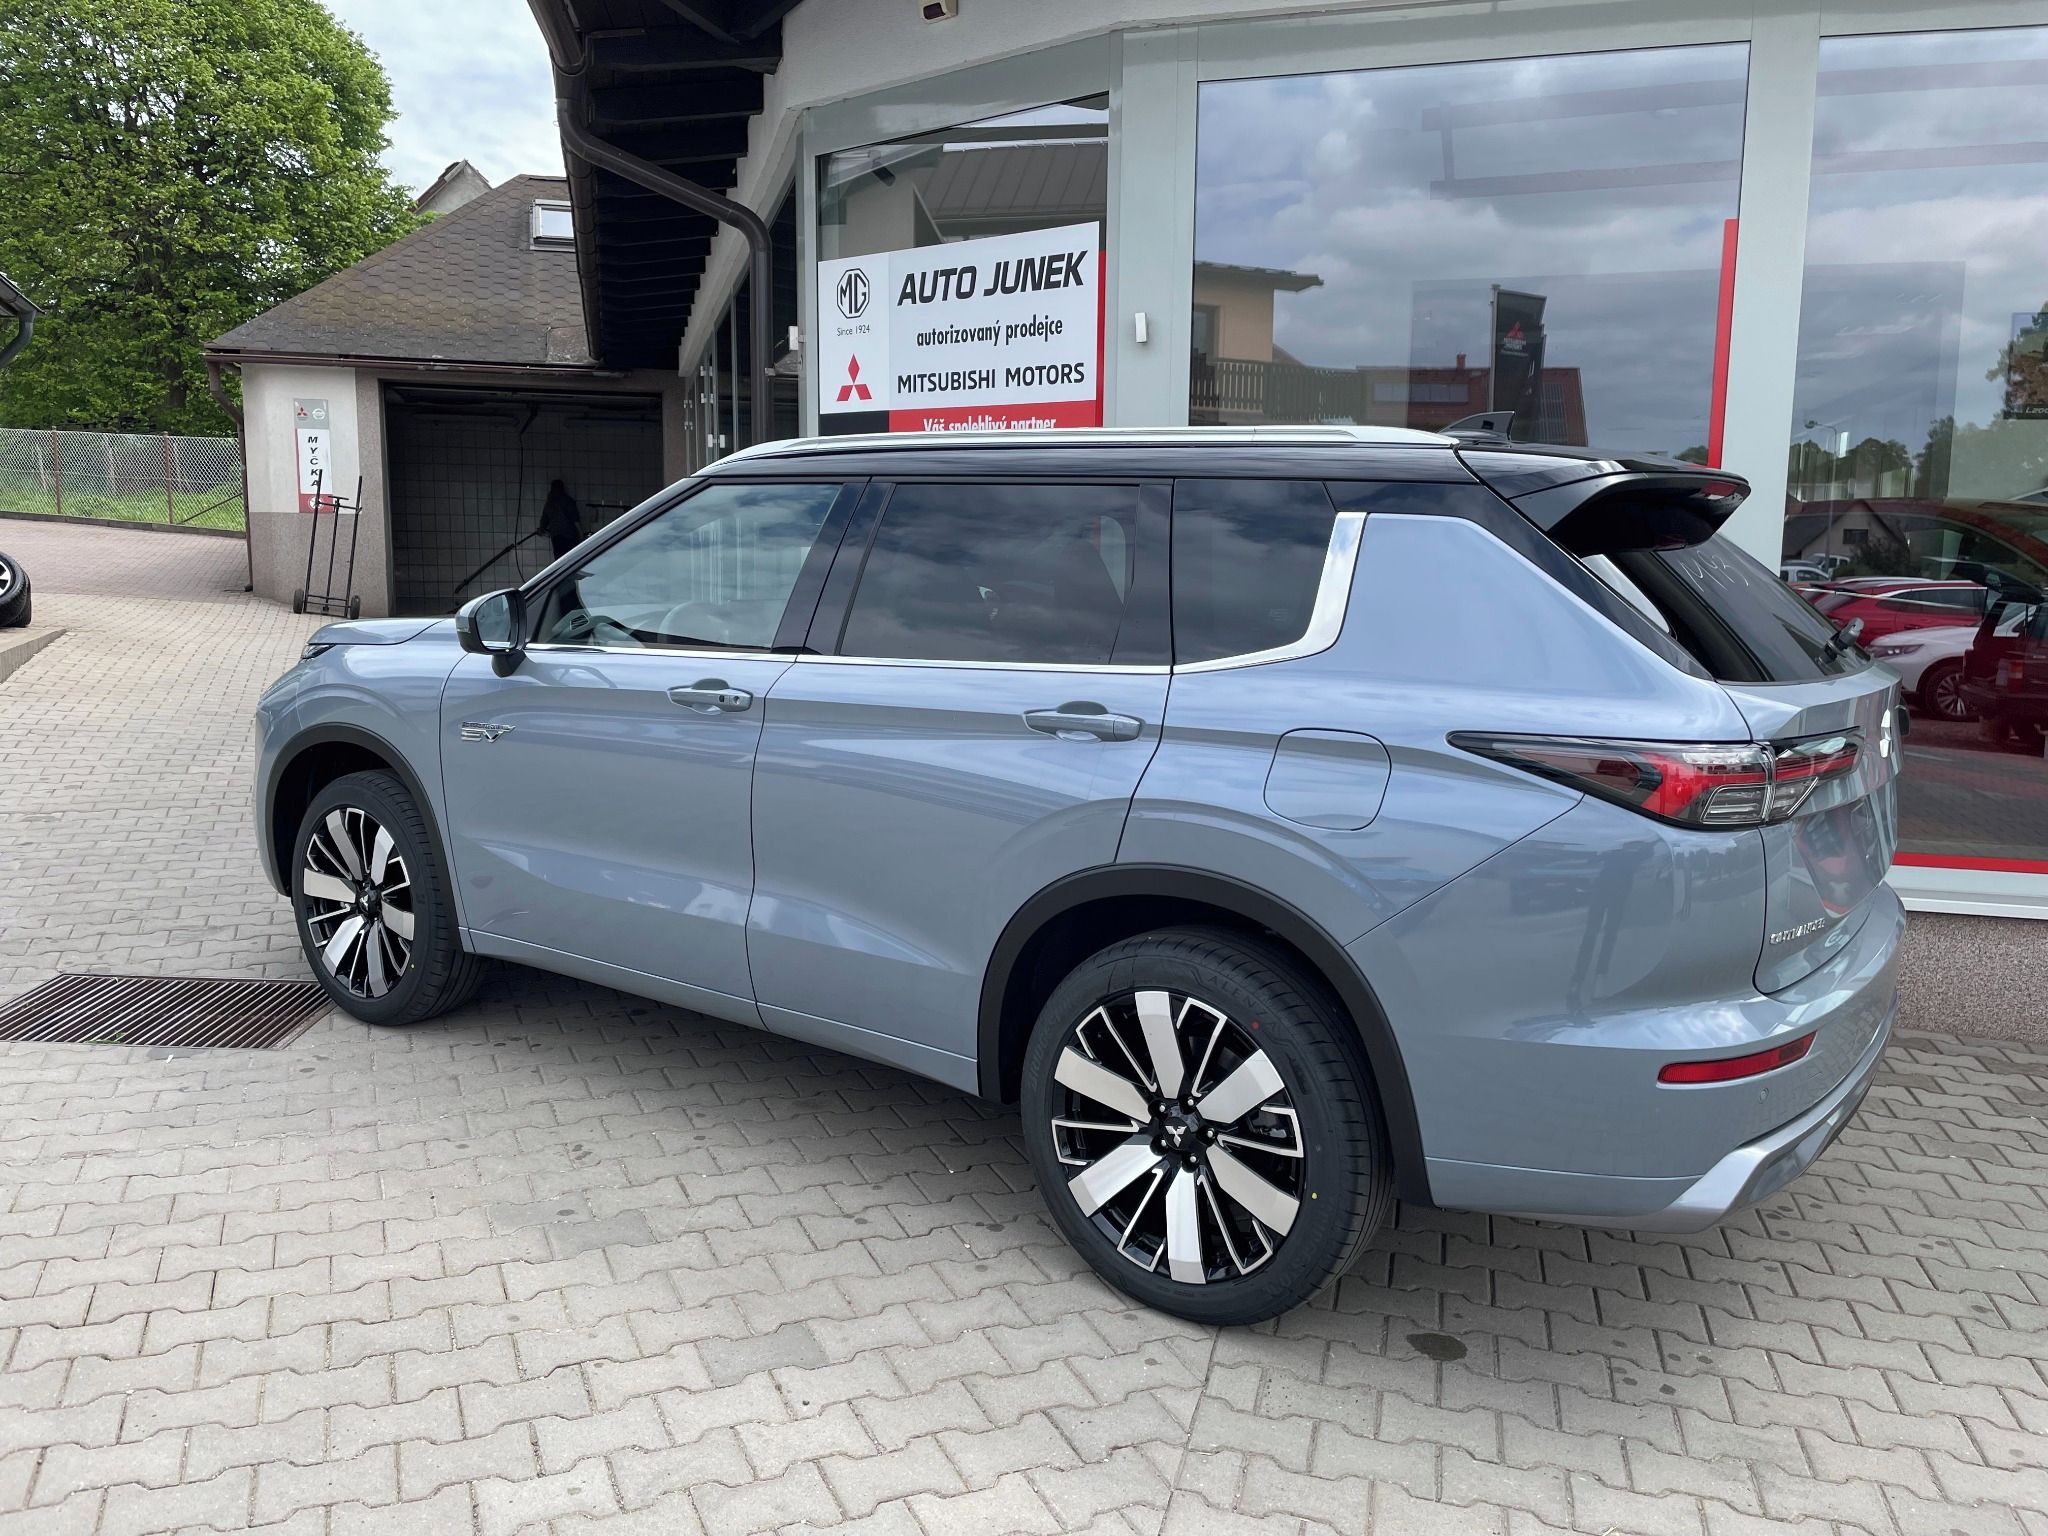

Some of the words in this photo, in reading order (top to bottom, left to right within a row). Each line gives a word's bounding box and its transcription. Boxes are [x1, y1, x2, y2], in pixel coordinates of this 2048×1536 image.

[840, 273, 867, 314] MG
[897, 265, 977, 306] AUTO
[983, 250, 1089, 297] JUNEK
[837, 327, 853, 337] Since
[856, 324, 871, 334] 1924
[916, 319, 1001, 347] autorizovaný
[1005, 314, 1063, 346] prodejce
[897, 368, 996, 394] MITSUBISHI
[1005, 362, 1085, 388] MOTORS
[923, 418, 945, 432] Váš
